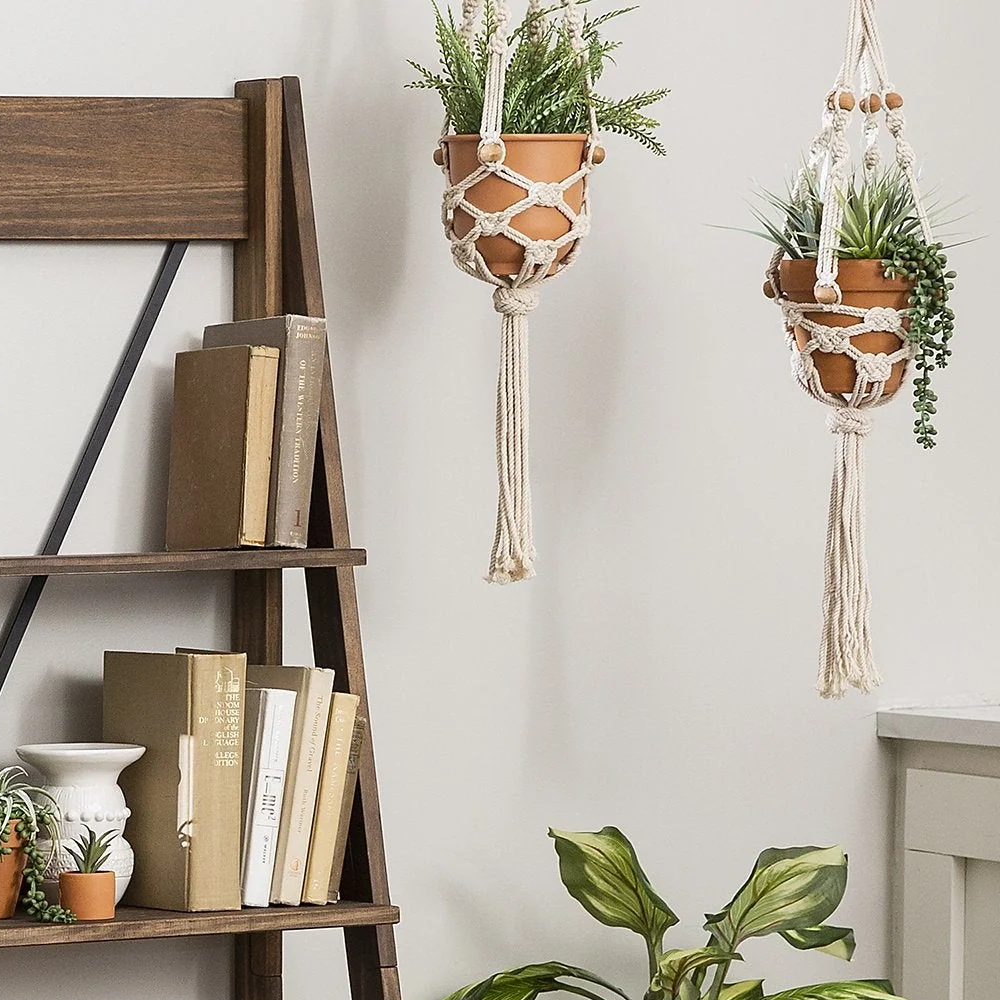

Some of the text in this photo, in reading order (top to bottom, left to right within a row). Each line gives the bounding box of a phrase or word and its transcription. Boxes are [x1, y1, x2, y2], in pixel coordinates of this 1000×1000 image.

[292, 360, 306, 484] OF THE WESTERN TRADITION
[316, 695, 324, 710] The
[311, 711, 321, 737] Sound
[306, 747, 316, 772] Gravel
